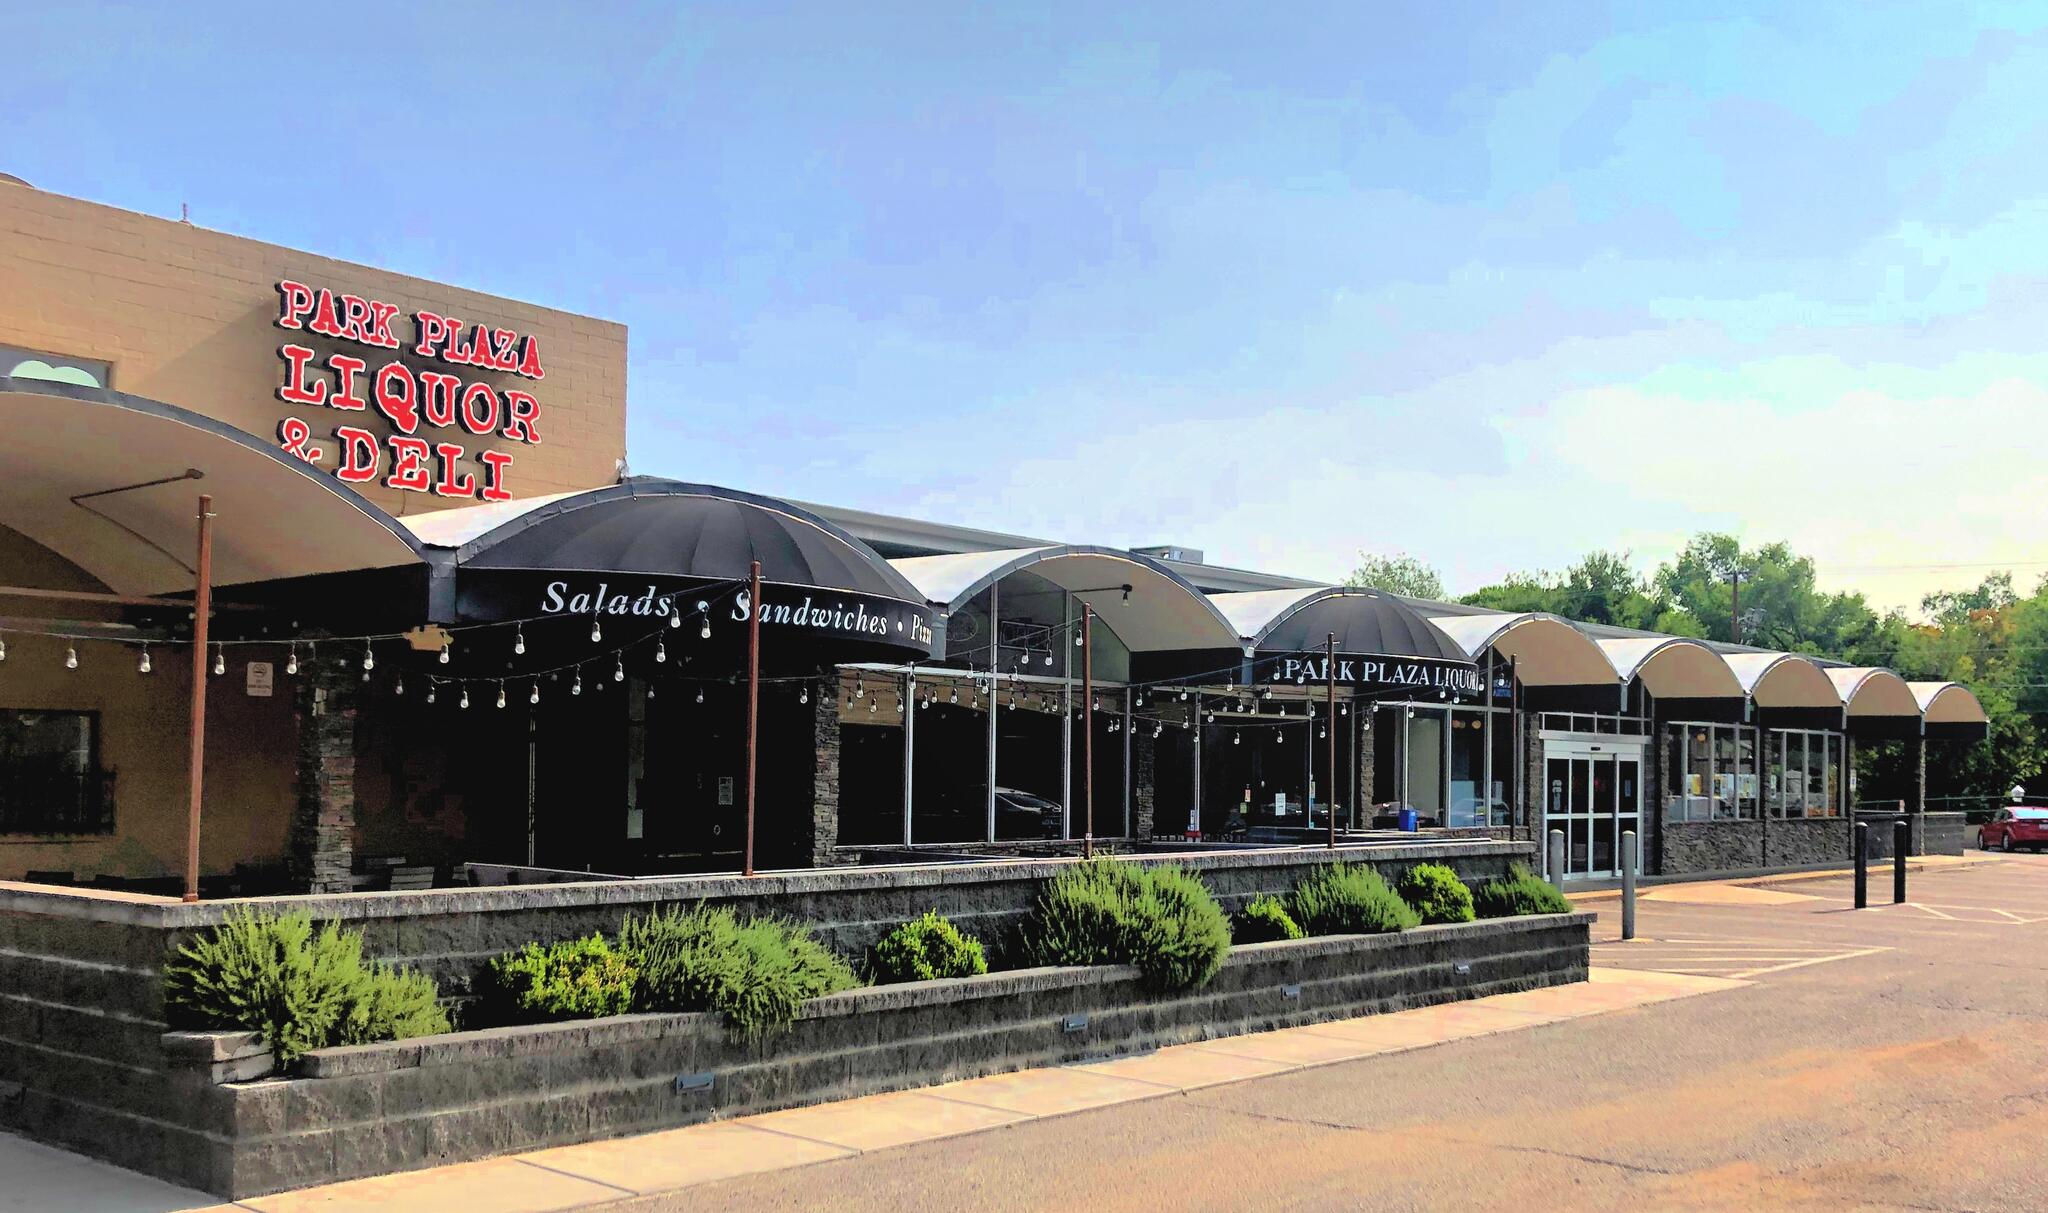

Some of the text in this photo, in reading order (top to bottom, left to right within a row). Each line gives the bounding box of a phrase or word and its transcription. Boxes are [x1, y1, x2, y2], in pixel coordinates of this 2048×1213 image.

[279, 280, 545, 379] PARK PLAZA
[279, 344, 542, 444] LIQUOR
[280, 417, 514, 501] & DELI
[542, 582, 672, 617] Salads
[731, 591, 888, 635] Sandwiches
[1284, 659, 1356, 681] PARK
[1363, 662, 1430, 686] PLAZA
